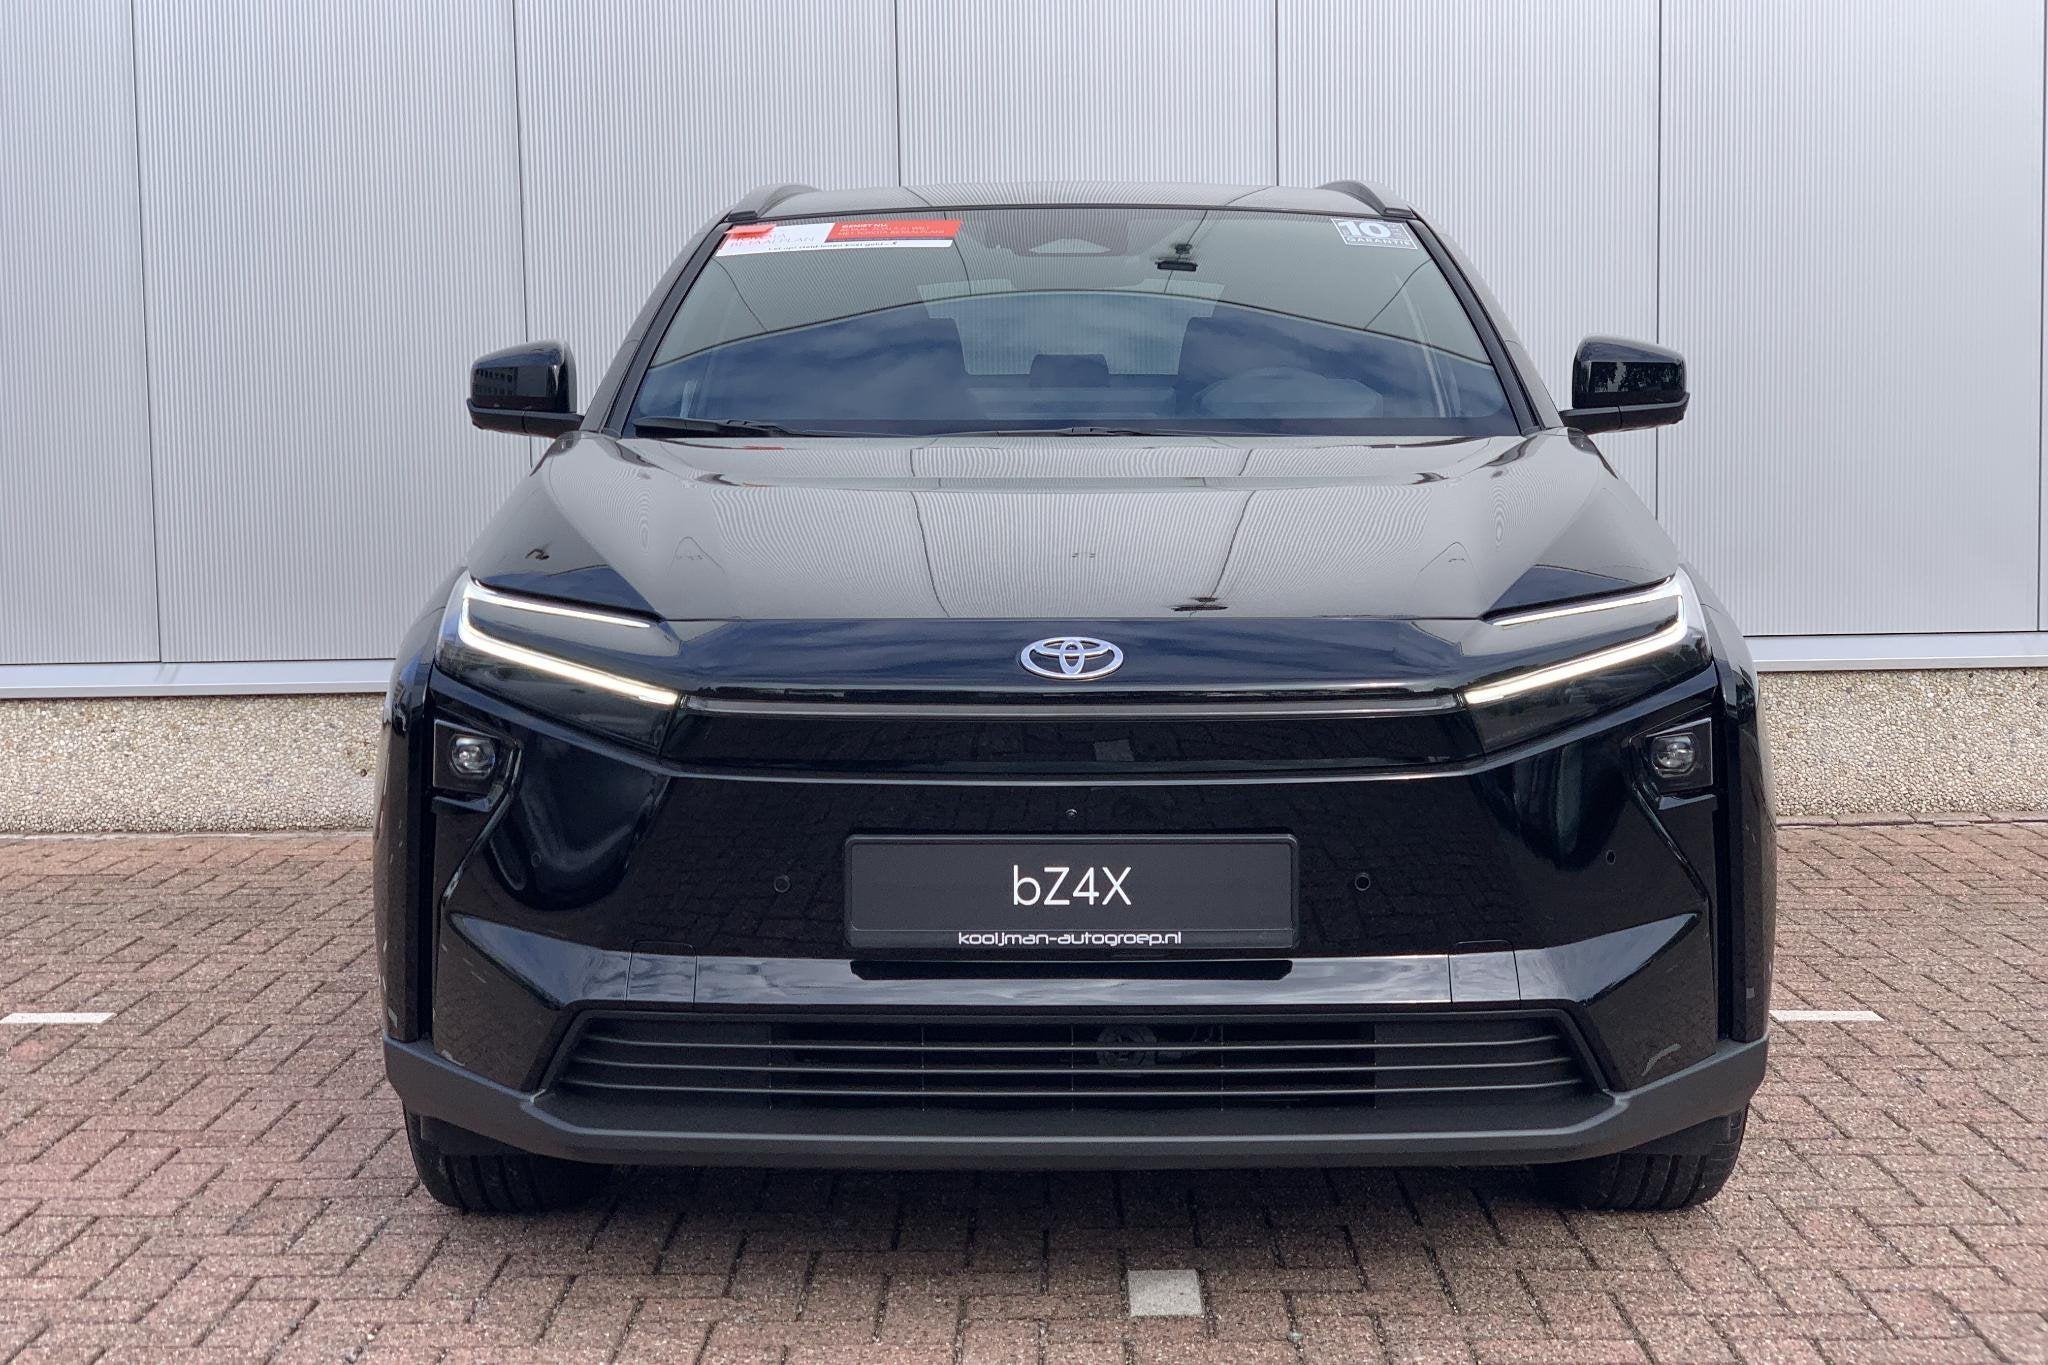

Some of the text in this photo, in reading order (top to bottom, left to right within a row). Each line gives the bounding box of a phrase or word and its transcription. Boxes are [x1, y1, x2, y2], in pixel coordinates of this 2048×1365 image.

[1338, 221, 1392, 238] 10
[1013, 865, 1132, 906] bZ4X
[958, 931, 1182, 947] kooijman-autogroep.nl
